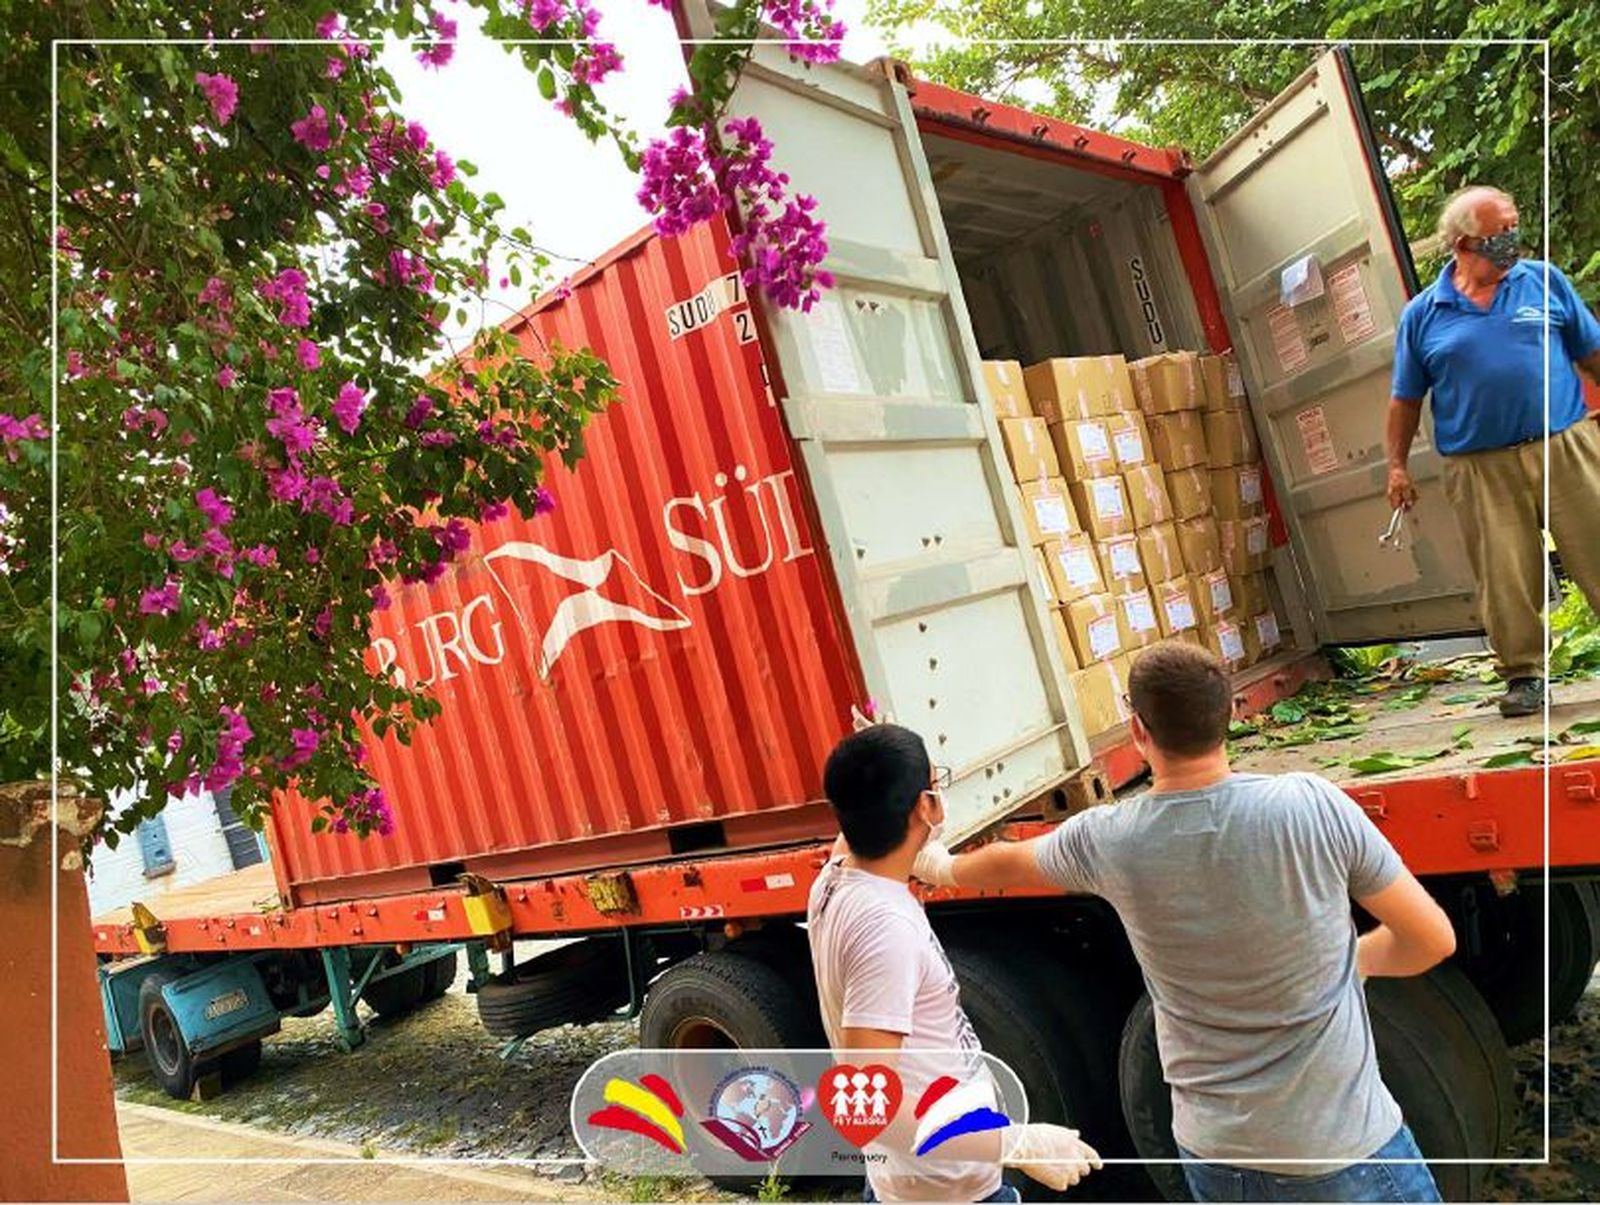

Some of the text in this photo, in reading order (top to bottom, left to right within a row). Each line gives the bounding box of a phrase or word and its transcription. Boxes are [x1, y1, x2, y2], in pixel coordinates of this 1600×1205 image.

[726, 273, 740, 302] 7
[1131, 258, 1163, 344] SUDU
[736, 313, 753, 342] 2
